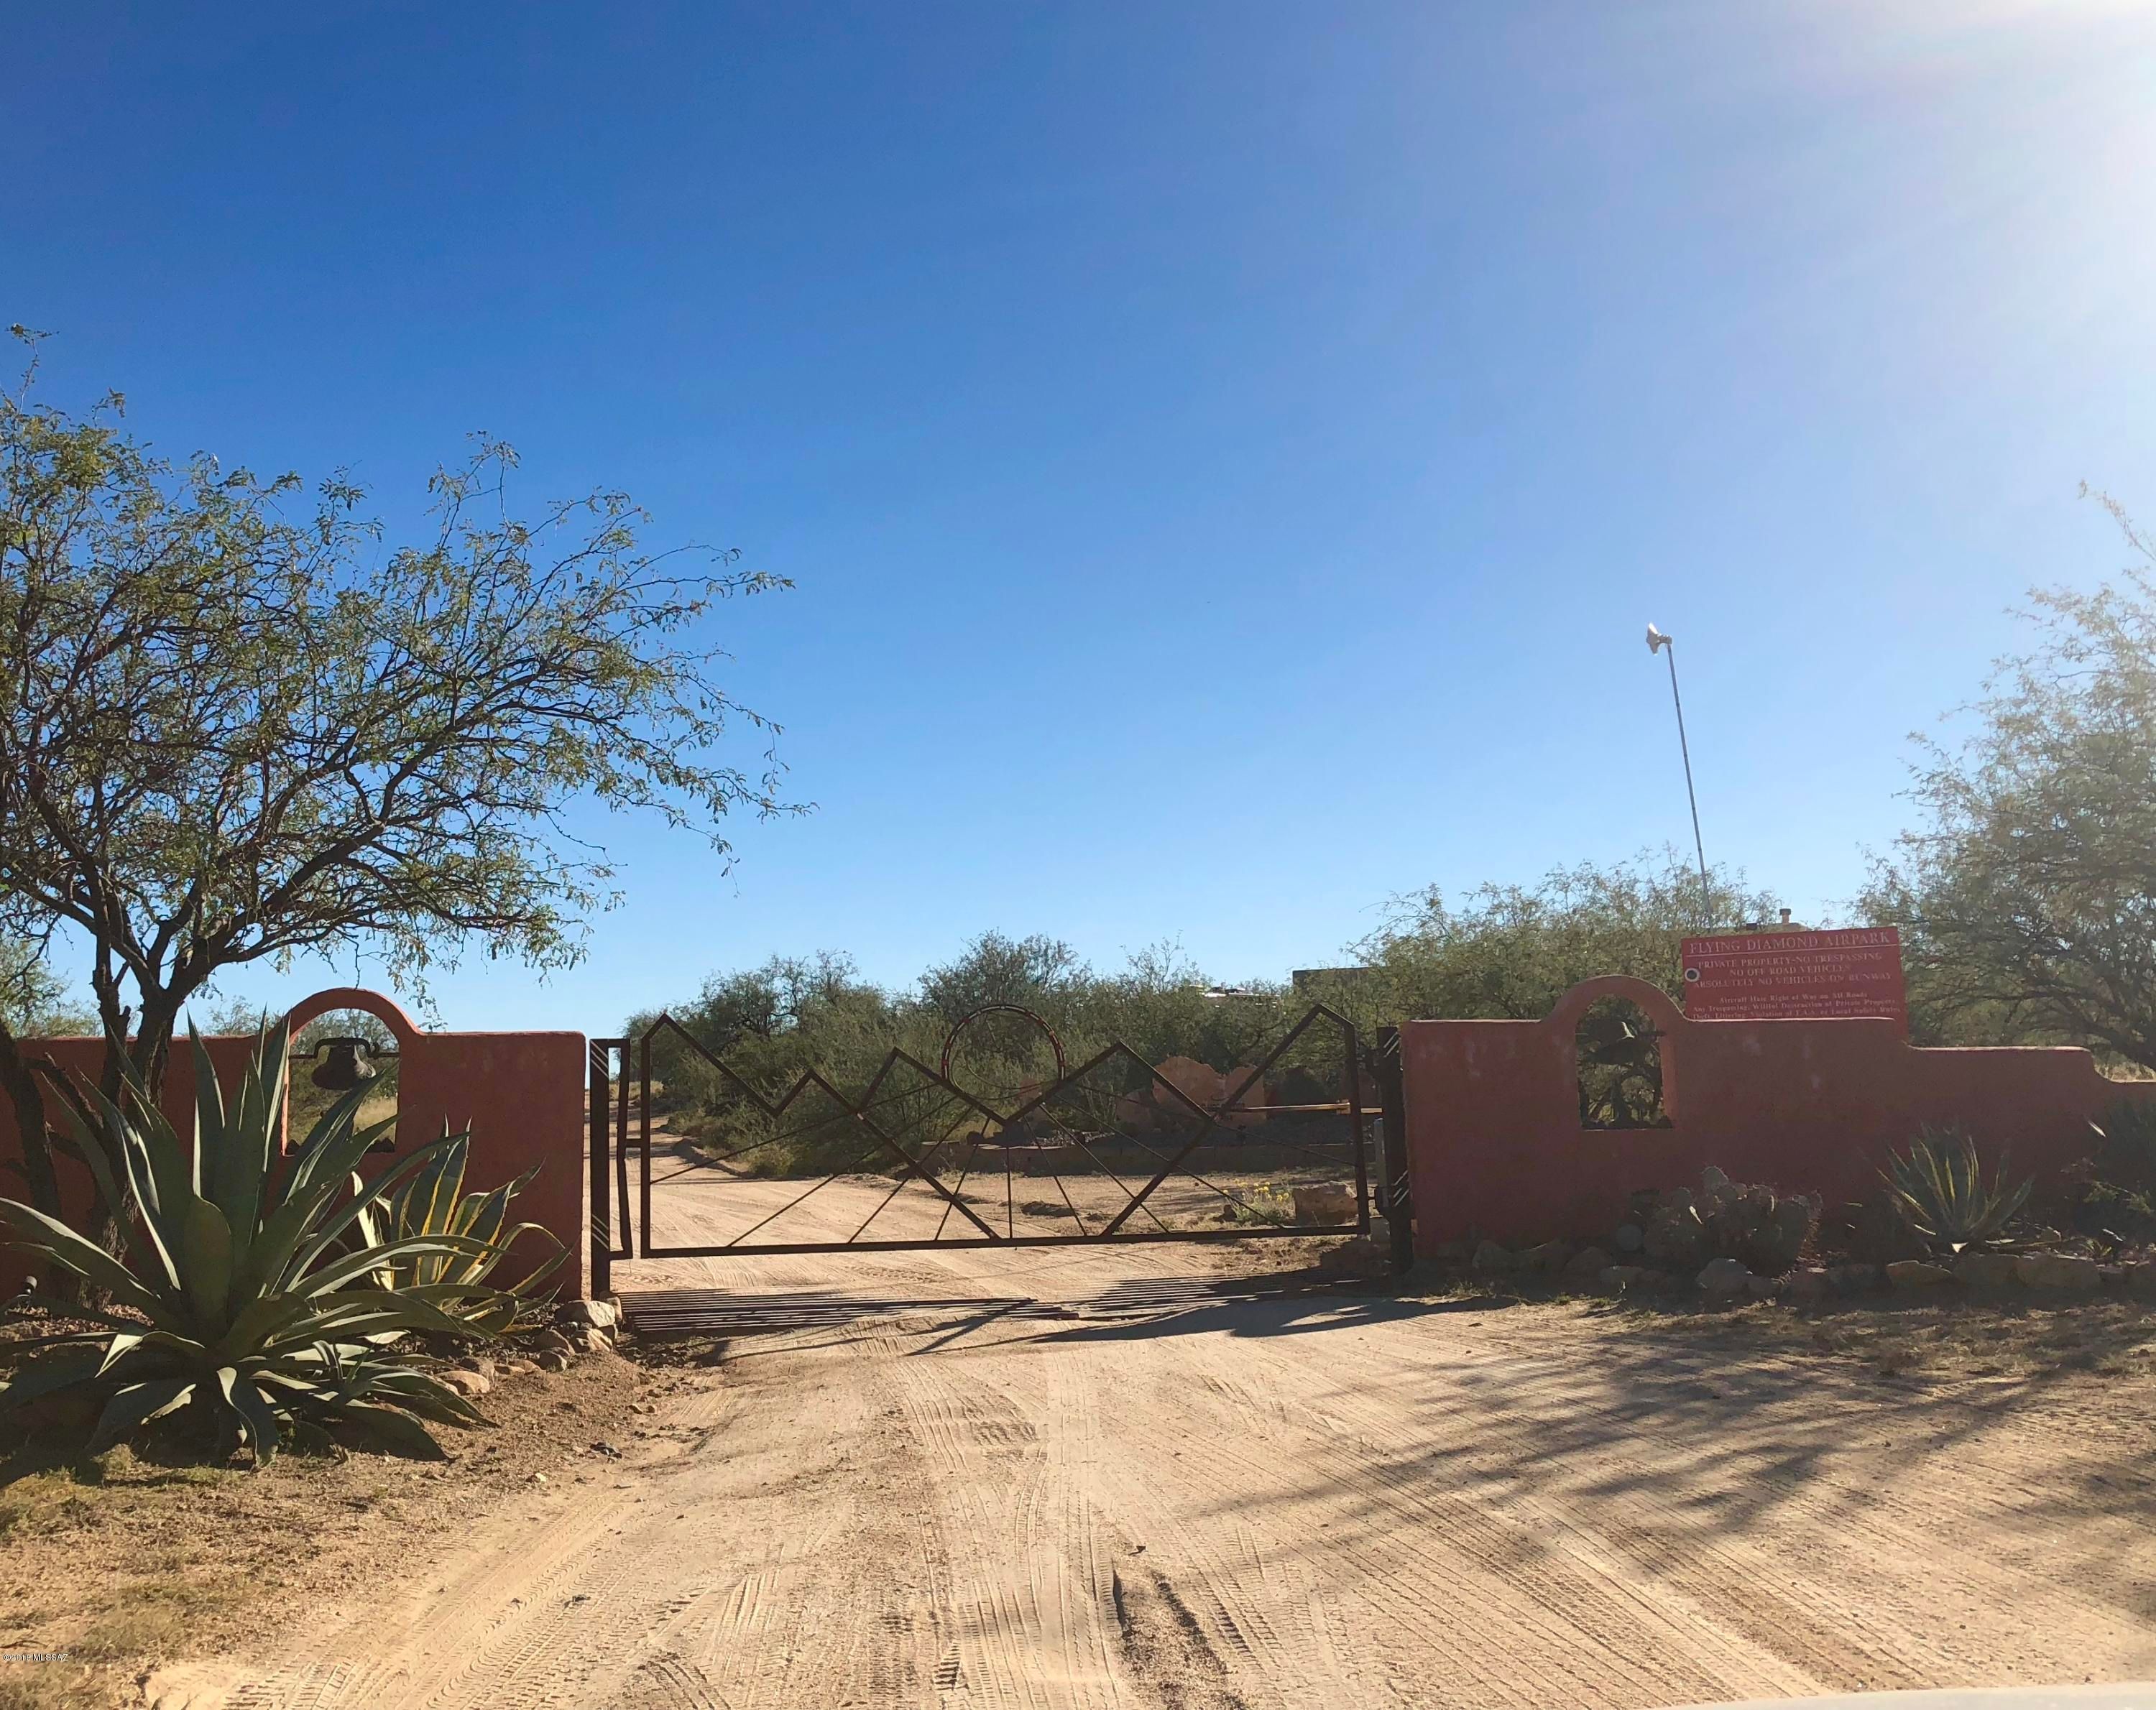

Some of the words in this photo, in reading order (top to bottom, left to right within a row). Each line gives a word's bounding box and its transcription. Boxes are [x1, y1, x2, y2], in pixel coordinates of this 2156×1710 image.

[1690, 940, 1740, 953] FLYING
[1747, 936, 1818, 951] DIAMOND
[1825, 931, 1889, 946] AIRPARK
[1698, 959, 1737, 969] PRIVATE
[1815, 952, 1882, 963] TRESPASSING
[1730, 969, 1743, 977] NO
[1770, 966, 1796, 975] ROAD
[1800, 964, 1851, 974] VEHICLES
[1695, 978, 1754, 989] ABSOLUTELY
[1776, 975, 1826, 984] VEHICLES
[1829, 974, 1844, 983] ON
[1848, 971, 1892, 981] RUNWAY
[1770, 994, 1789, 1002] Right
